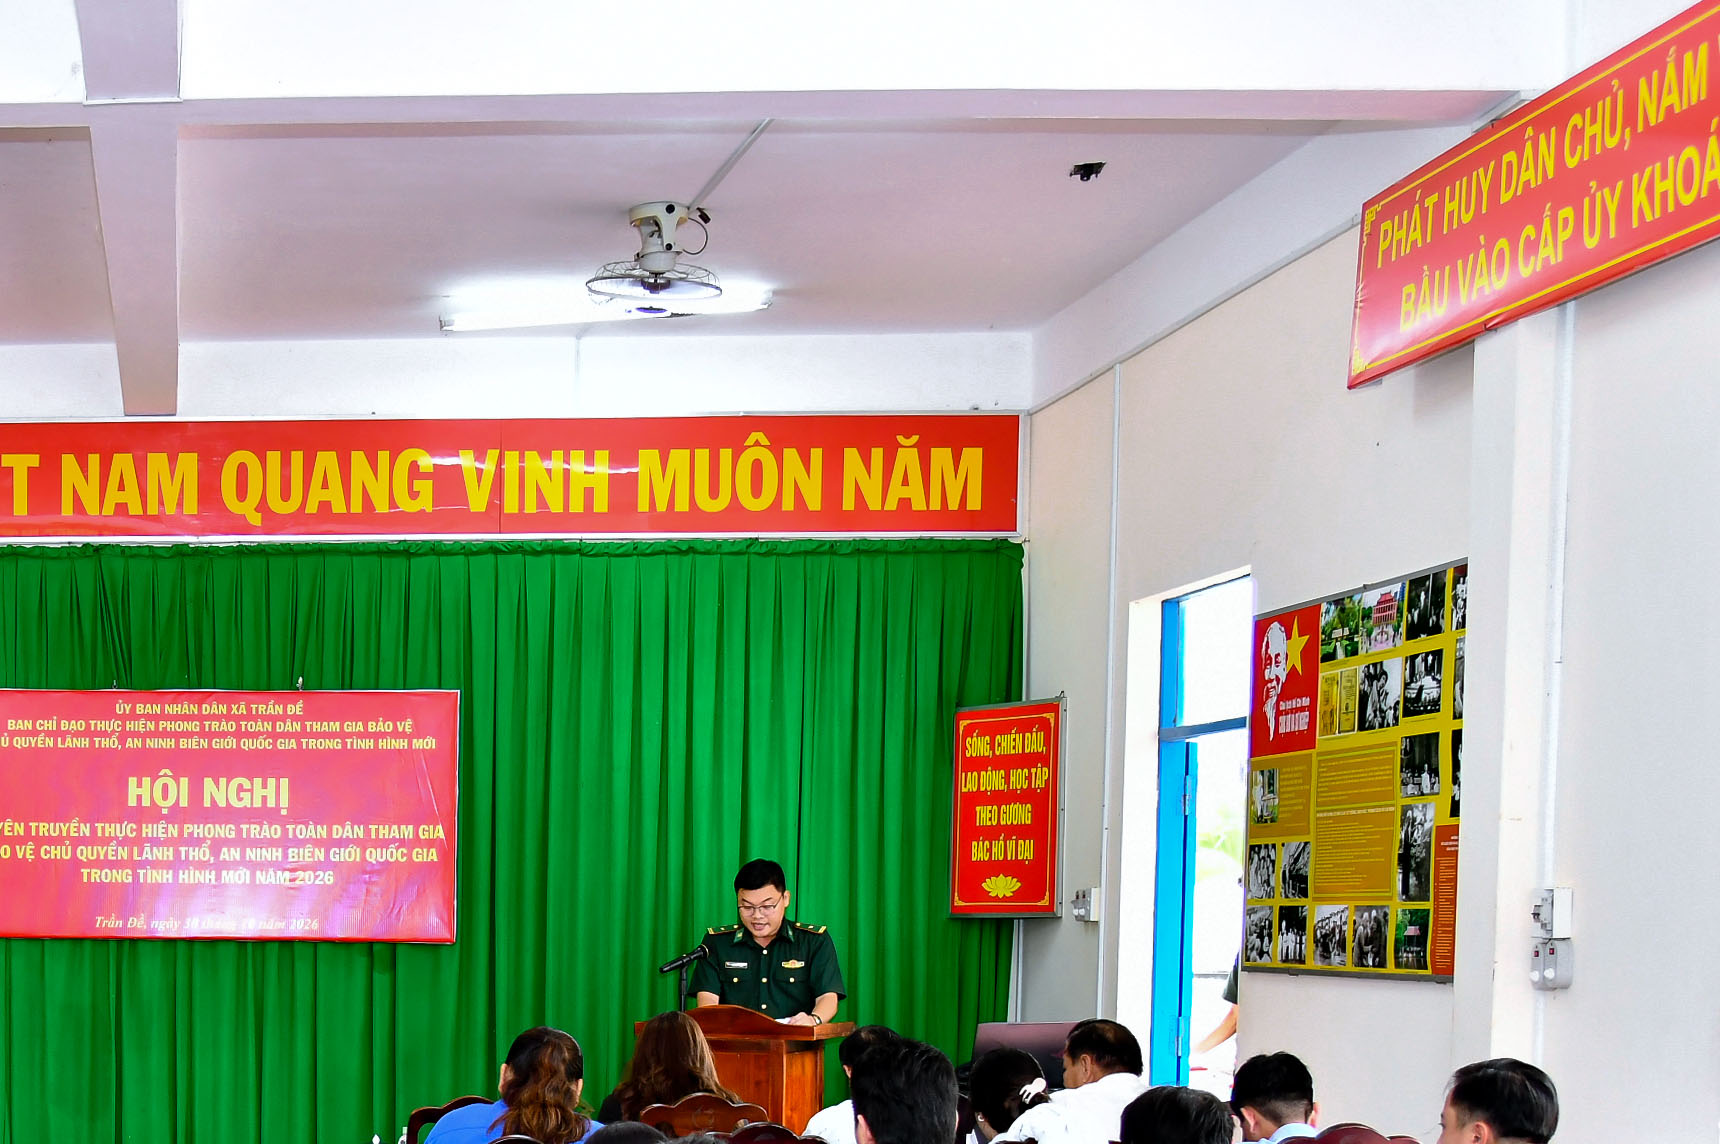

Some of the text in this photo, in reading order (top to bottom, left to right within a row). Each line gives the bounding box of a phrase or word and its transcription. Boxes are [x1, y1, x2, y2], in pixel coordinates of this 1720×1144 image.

[1377, 41, 1709, 268] PHÁT HUY DÂN CHỦ, NẮM
[1400, 265, 1450, 333] BẦU
[1457, 235, 1510, 305] VÀO
[1517, 202, 1574, 278] CẤP
[1583, 180, 1623, 249] ỦY
[60, 453, 198, 517] NAM
[220, 448, 434, 527] QUANG
[458, 448, 609, 514] VINH
[637, 431, 823, 512] MUÔN
[842, 434, 983, 512] NĂM
[116, 700, 303, 714] ỦY BAN NHÂN DÂN XÃ TRẦN ĐỀ
[8, 716, 412, 733] BAN CHỈ ĐẠO THỰC HIỆN PHONG TRÀO TOÀN DÂN THAM GIA BẢO VỆ
[13, 733, 53, 748] QUYỀN
[58, 735, 89, 747] LÃNH
[94, 733, 121, 750] THỔ,
[126, 738, 141, 748] AN
[146, 738, 174, 748] NINH
[180, 736, 208, 748] BIÊN
[212, 736, 236, 748] GIỚI
[240, 735, 272, 750] QUỐC
[277, 739, 296, 749] GIA
[301, 739, 341, 749] TRONG
[346, 736, 373, 749] TÌNH
[379, 737, 408, 749] HÌNH
[413, 736, 435, 749] MỚI
[965, 724, 1046, 758] SỐNG, CHIẾN ĐẤU,
[128, 769, 288, 815] HỘI NGHỊ
[962, 763, 1049, 795] LAO ĐỘNG, HỌC TẬP
[976, 803, 1031, 825] THEO GƯƠNG
[29, 818, 90, 836] TRUYỀN
[95, 821, 136, 840] THỰC
[142, 821, 178, 840] HIỆN
[184, 823, 235, 839] PHONG
[240, 821, 282, 838] TRÀO
[286, 821, 327, 839] TOÀN
[332, 821, 363, 838] DÂN
[369, 825, 413, 839] THAM
[419, 824, 445, 840] GIA
[16, 842, 35, 861] VỆ
[41, 841, 71, 859] CHỦ
[77, 841, 129, 862] QUYỀN
[133, 843, 174, 861] LÃNH
[179, 840, 215, 864] THỔ,
[219, 847, 241, 862] AN
[245, 847, 282, 862] NINH
[287, 844, 324, 862] BIÊN
[330, 844, 360, 862] GIỚI
[366, 843, 407, 864] QUỐC
[412, 848, 438, 862] GIA
[972, 834, 1033, 864] BÁC HỒ VĨ ĐẠI
[81, 866, 334, 885] TRONG TÌNH HÌNH MỚI NĂM 2026
